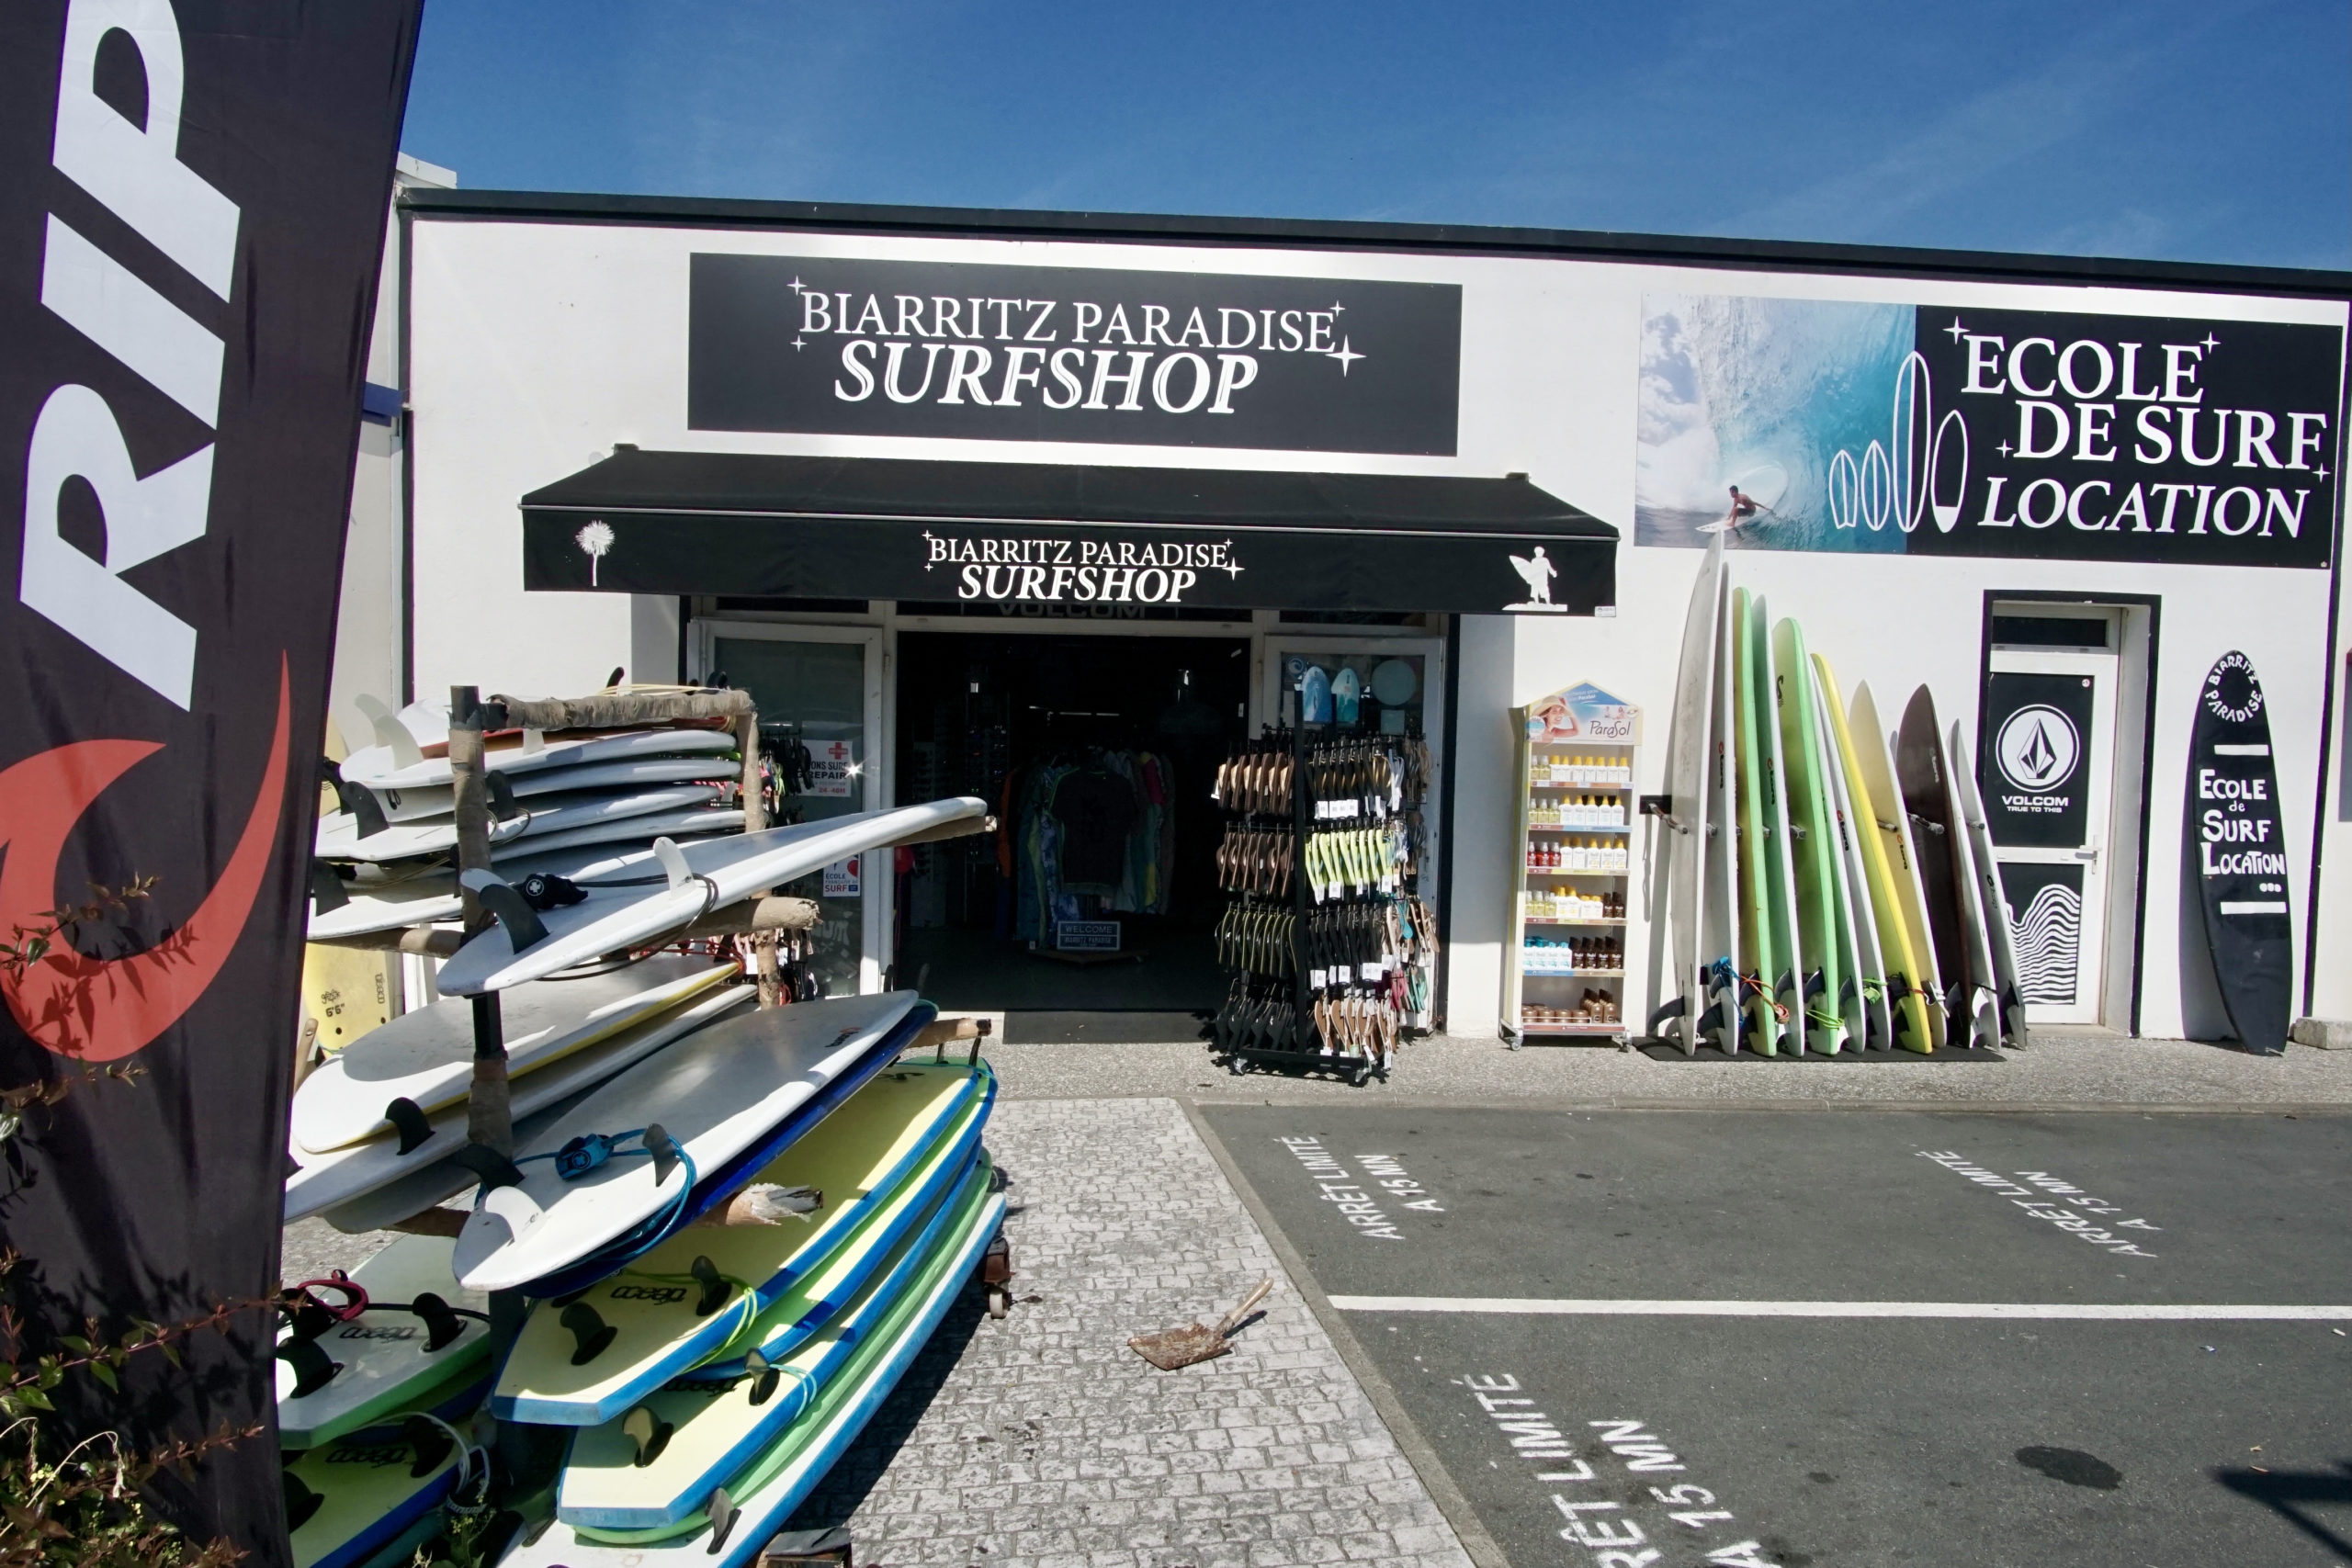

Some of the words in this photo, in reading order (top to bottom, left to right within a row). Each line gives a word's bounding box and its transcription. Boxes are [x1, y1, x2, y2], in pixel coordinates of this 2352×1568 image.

[799, 291, 1057, 344] BIARRITZ
[1074, 301, 1337, 354] PARADISE
[19, 0, 241, 712] RIP
[1962, 334, 2204, 403] ECOLE
[834, 340, 1258, 414] SURFSHOP
[2013, 400, 2117, 461] DE
[2134, 405, 2328, 470] SURF
[1977, 476, 2310, 538] LOCATION
[929, 538, 1072, 564] BIARRITZ
[1080, 541, 1228, 569] PARADISE
[958, 565, 1195, 603] SURFSHOP
[2208, 654, 2257, 685] BIARRITZ
[2205, 690, 2263, 723] PARADISE
[1589, 720, 1631, 738] ParaSol
[2001, 795, 2069, 807] VOLCOM
[2199, 769, 2267, 800] ECOLE
[2229, 800, 2245, 812] de
[2201, 809, 2271, 842] SURF
[2199, 842, 2286, 875] LOCATION
[1066, 925, 1113, 933] WELCOME
[1354, 1155, 1408, 1175] MN
[1379, 1179, 1427, 1196] 15
[2014, 1171, 2086, 1193] MN
[2066, 1197, 2122, 1213] 15
[1588, 1420, 1688, 1471] MN
[1649, 1483, 1735, 1528] 15
